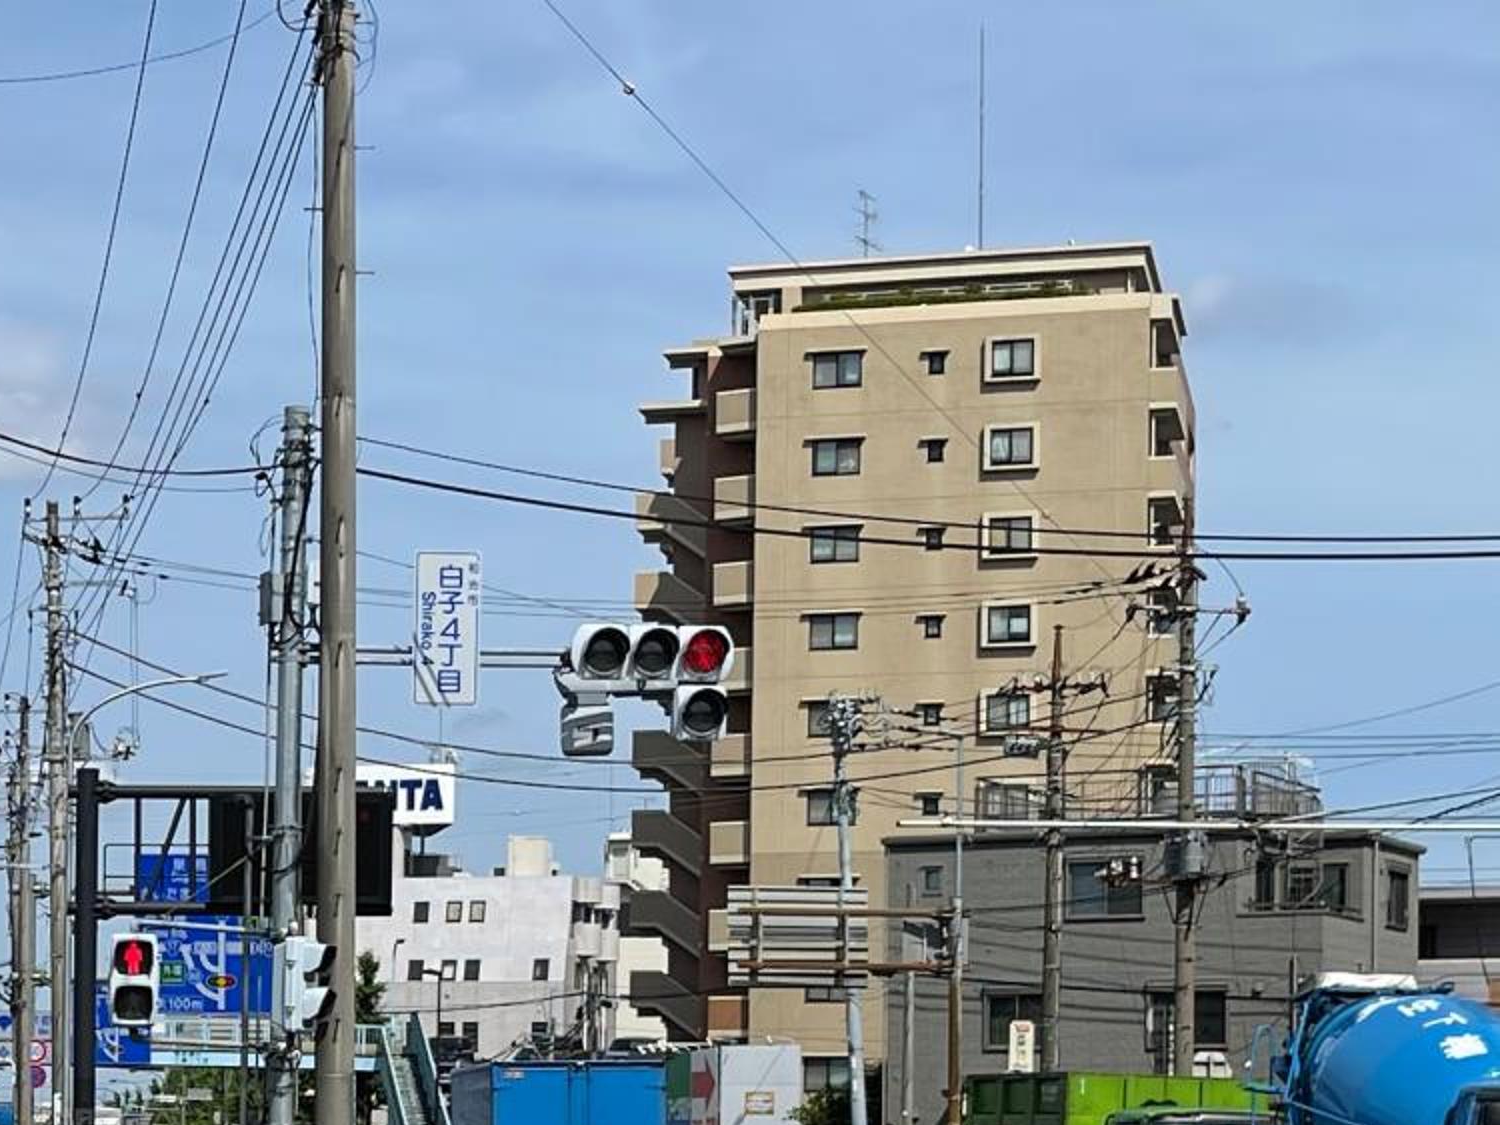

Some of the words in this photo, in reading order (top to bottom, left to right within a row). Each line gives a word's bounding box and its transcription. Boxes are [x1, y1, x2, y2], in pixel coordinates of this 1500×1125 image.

[421, 591, 437, 650] Shirako
[437, 565, 464, 693] 白子4丁目
